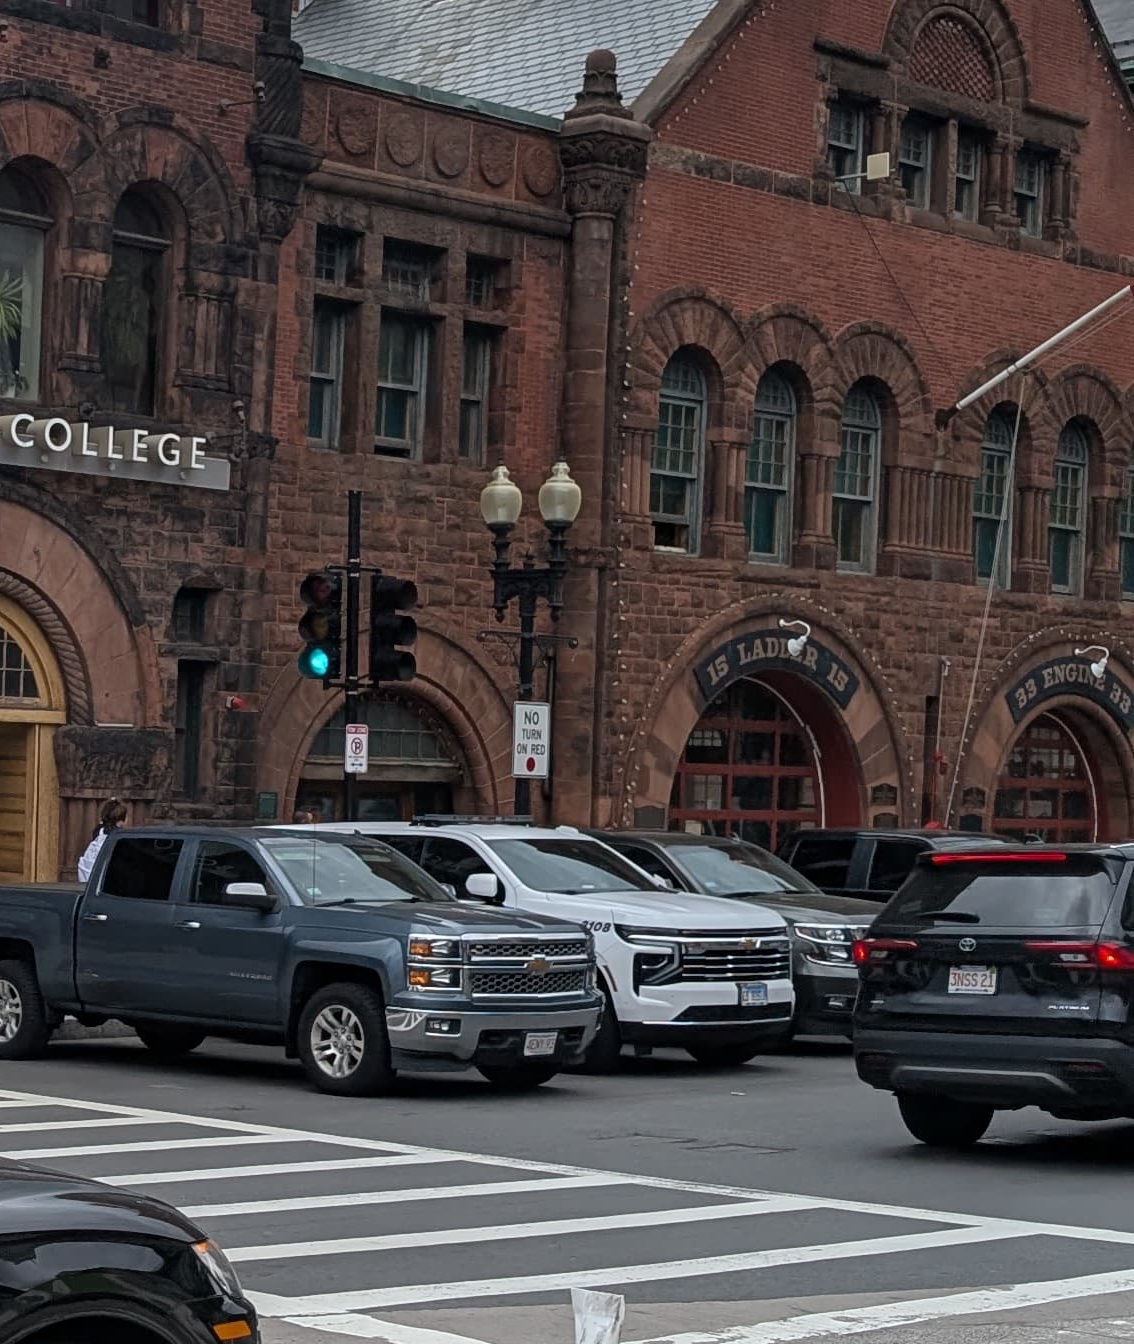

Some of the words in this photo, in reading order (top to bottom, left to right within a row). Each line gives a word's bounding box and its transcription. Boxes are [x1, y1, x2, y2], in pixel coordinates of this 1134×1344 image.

[6, 413, 207, 470] COLLEGE
[706, 654, 730, 686] 15
[1015, 678, 1037, 709] 33
[524, 711, 539, 725] NO
[522, 729, 542, 740] TURN
[517, 743, 528, 754] ON
[531, 744, 546, 755] RED
[951, 972, 978, 987] 3NSS
[980, 973, 994, 988] 21
